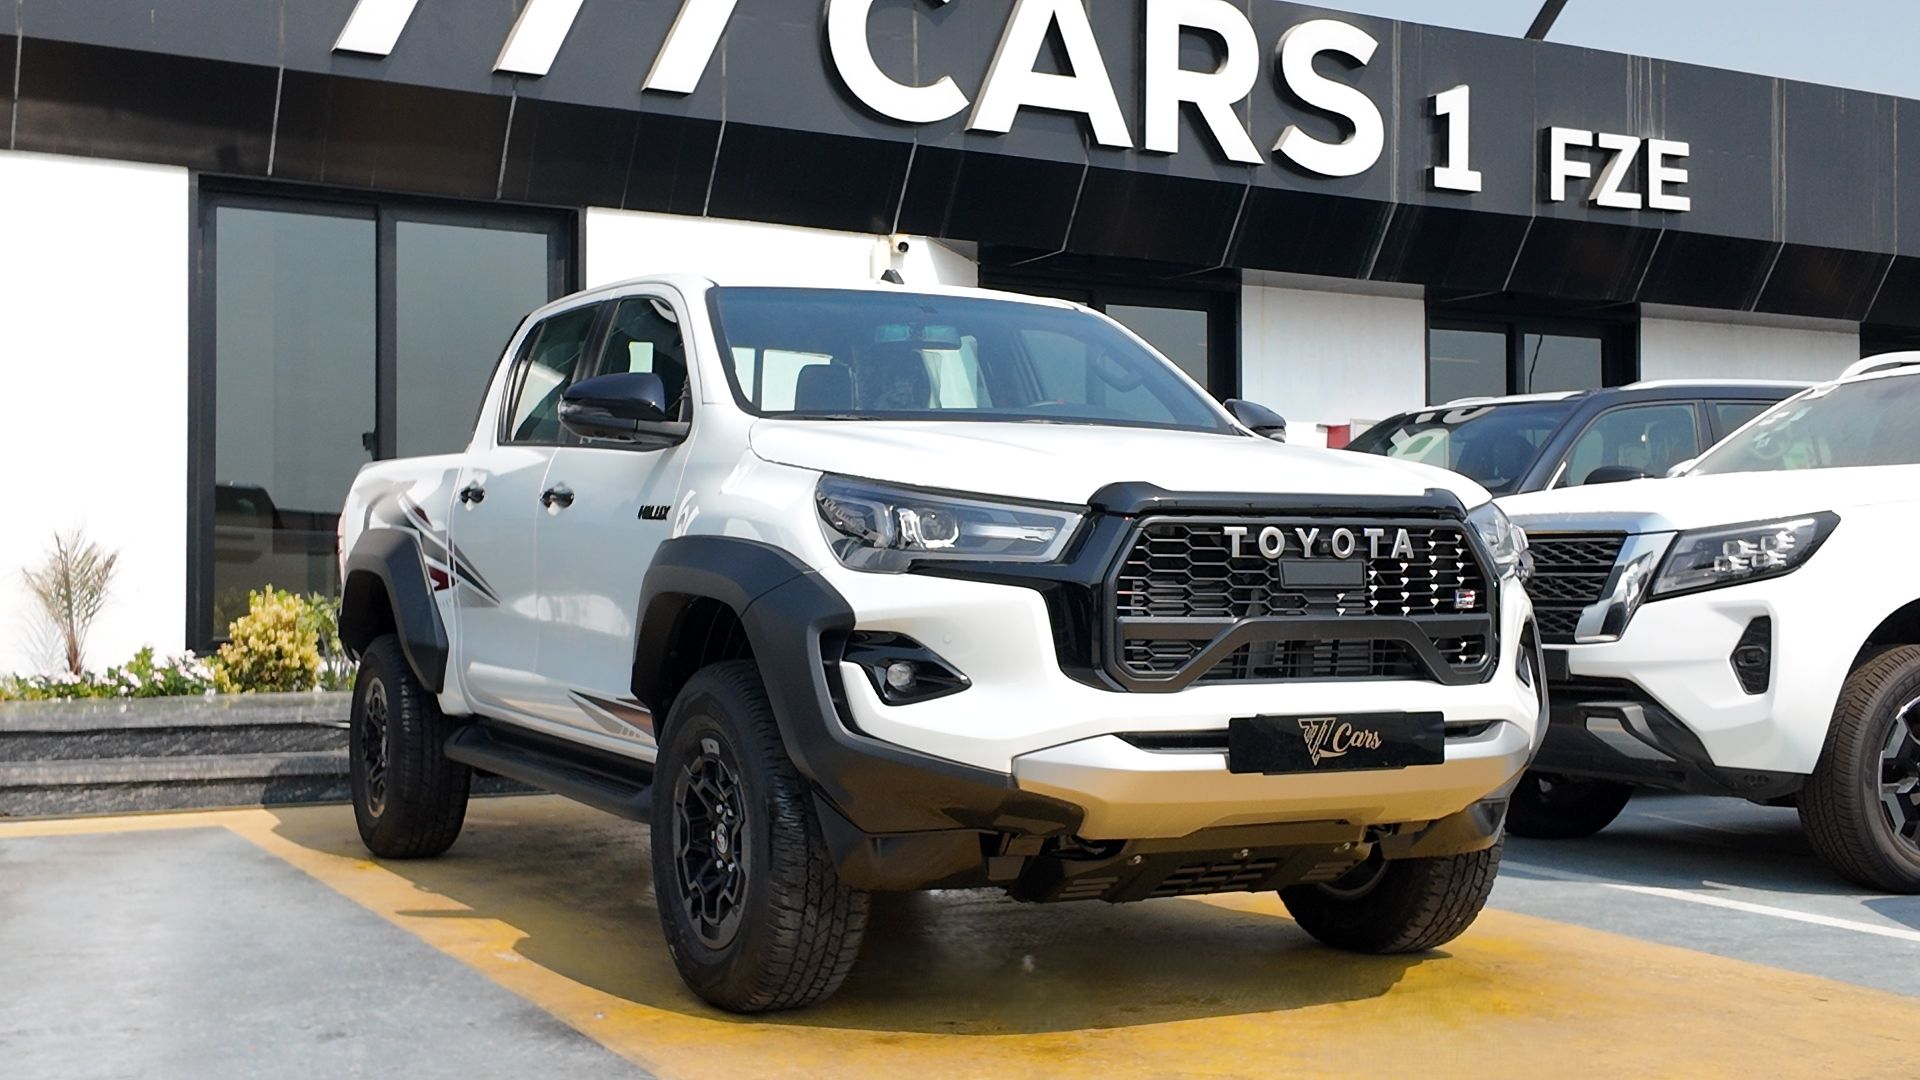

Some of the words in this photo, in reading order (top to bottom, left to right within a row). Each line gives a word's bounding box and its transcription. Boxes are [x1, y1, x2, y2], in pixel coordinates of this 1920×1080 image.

[826, 0, 1386, 177] CARS
[1433, 84, 1482, 193] 1
[1549, 126, 1691, 213] FZE
[1223, 526, 1415, 560] TOYOTA
[1332, 722, 1382, 753] Cars
